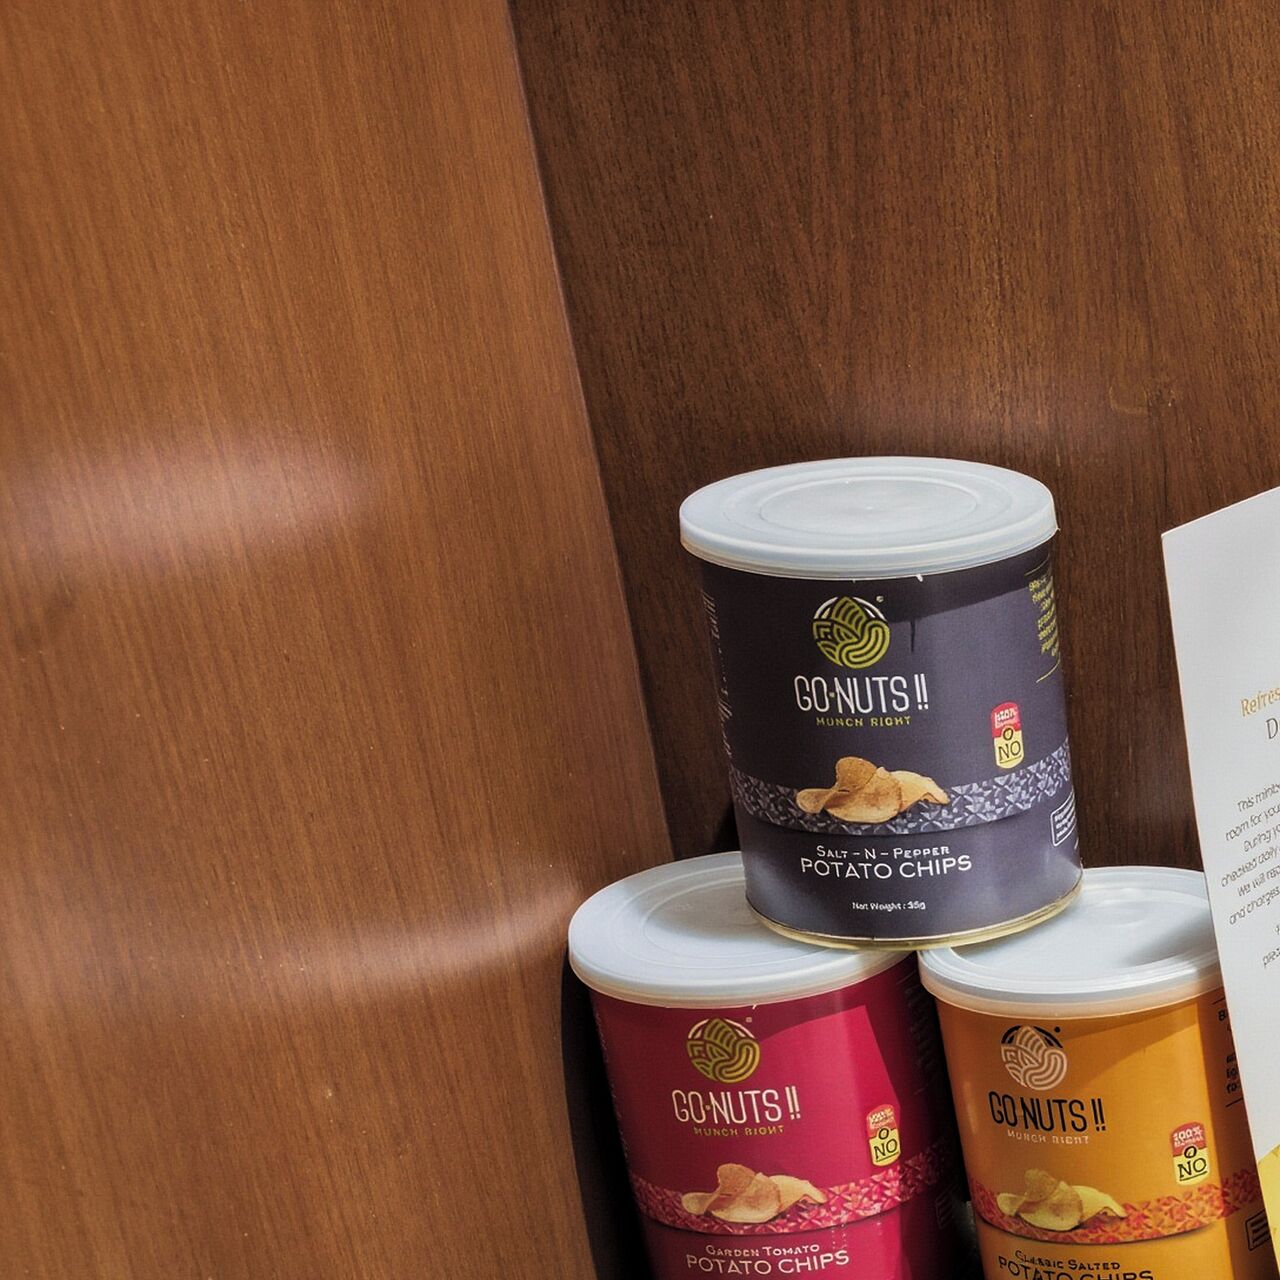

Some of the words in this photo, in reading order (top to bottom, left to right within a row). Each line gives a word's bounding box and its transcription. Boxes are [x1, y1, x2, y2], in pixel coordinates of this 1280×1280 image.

[816, 716, 863, 727] MUNCH
[871, 715, 911, 727] RIGHT
[816, 844, 848, 859] SALT
[864, 847, 876, 859] N
[893, 846, 951, 859] PEPPER
[800, 857, 893, 880] POTATO
[899, 854, 972, 879] CHIPS
[705, 1244, 759, 1257] GARDEN
[762, 1243, 820, 1257] TOMATO
[686, 1253, 772, 1276] POTATO
[777, 1250, 850, 1275] CHIPS
[1015, 1250, 1064, 1269] CLASSIC
[1067, 1259, 1121, 1271] SALTED
